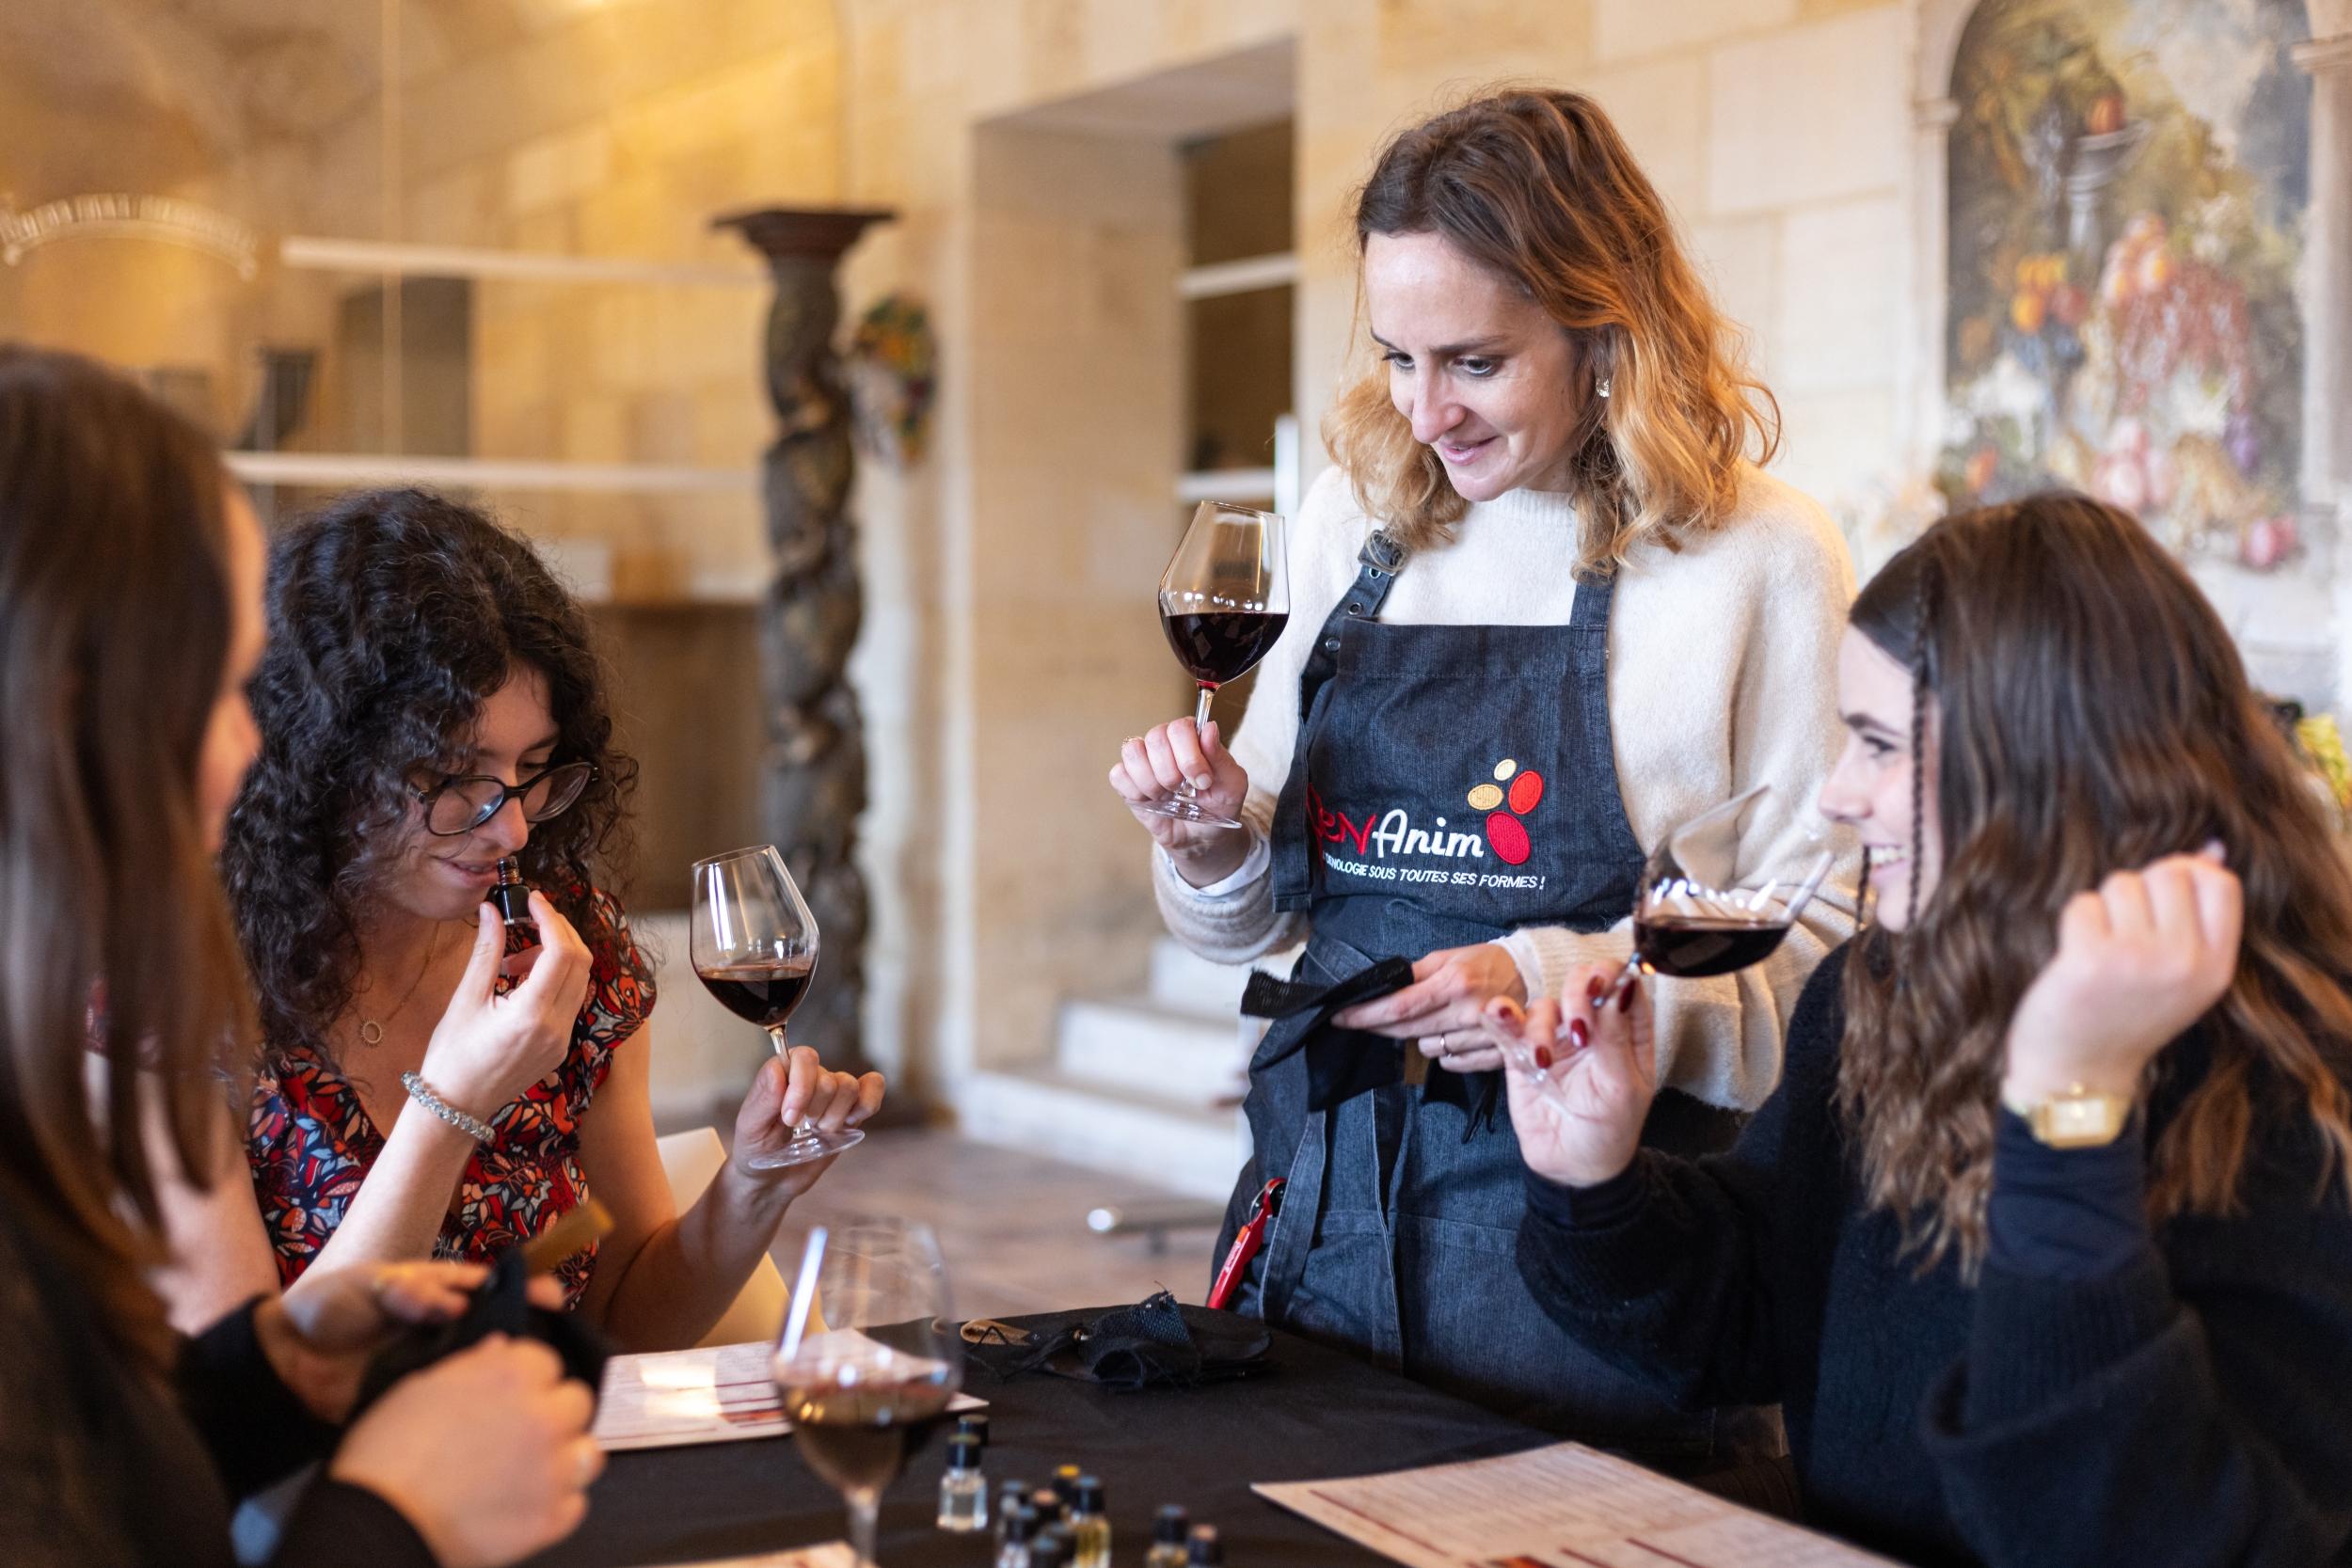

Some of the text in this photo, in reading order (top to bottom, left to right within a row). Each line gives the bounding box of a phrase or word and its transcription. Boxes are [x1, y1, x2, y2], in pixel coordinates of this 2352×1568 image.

[1368, 864, 1397, 880] SOUS
[1399, 868, 1449, 883] TOUTES
[1450, 871, 1477, 886] SES
[1478, 874, 1537, 889] FORMES
